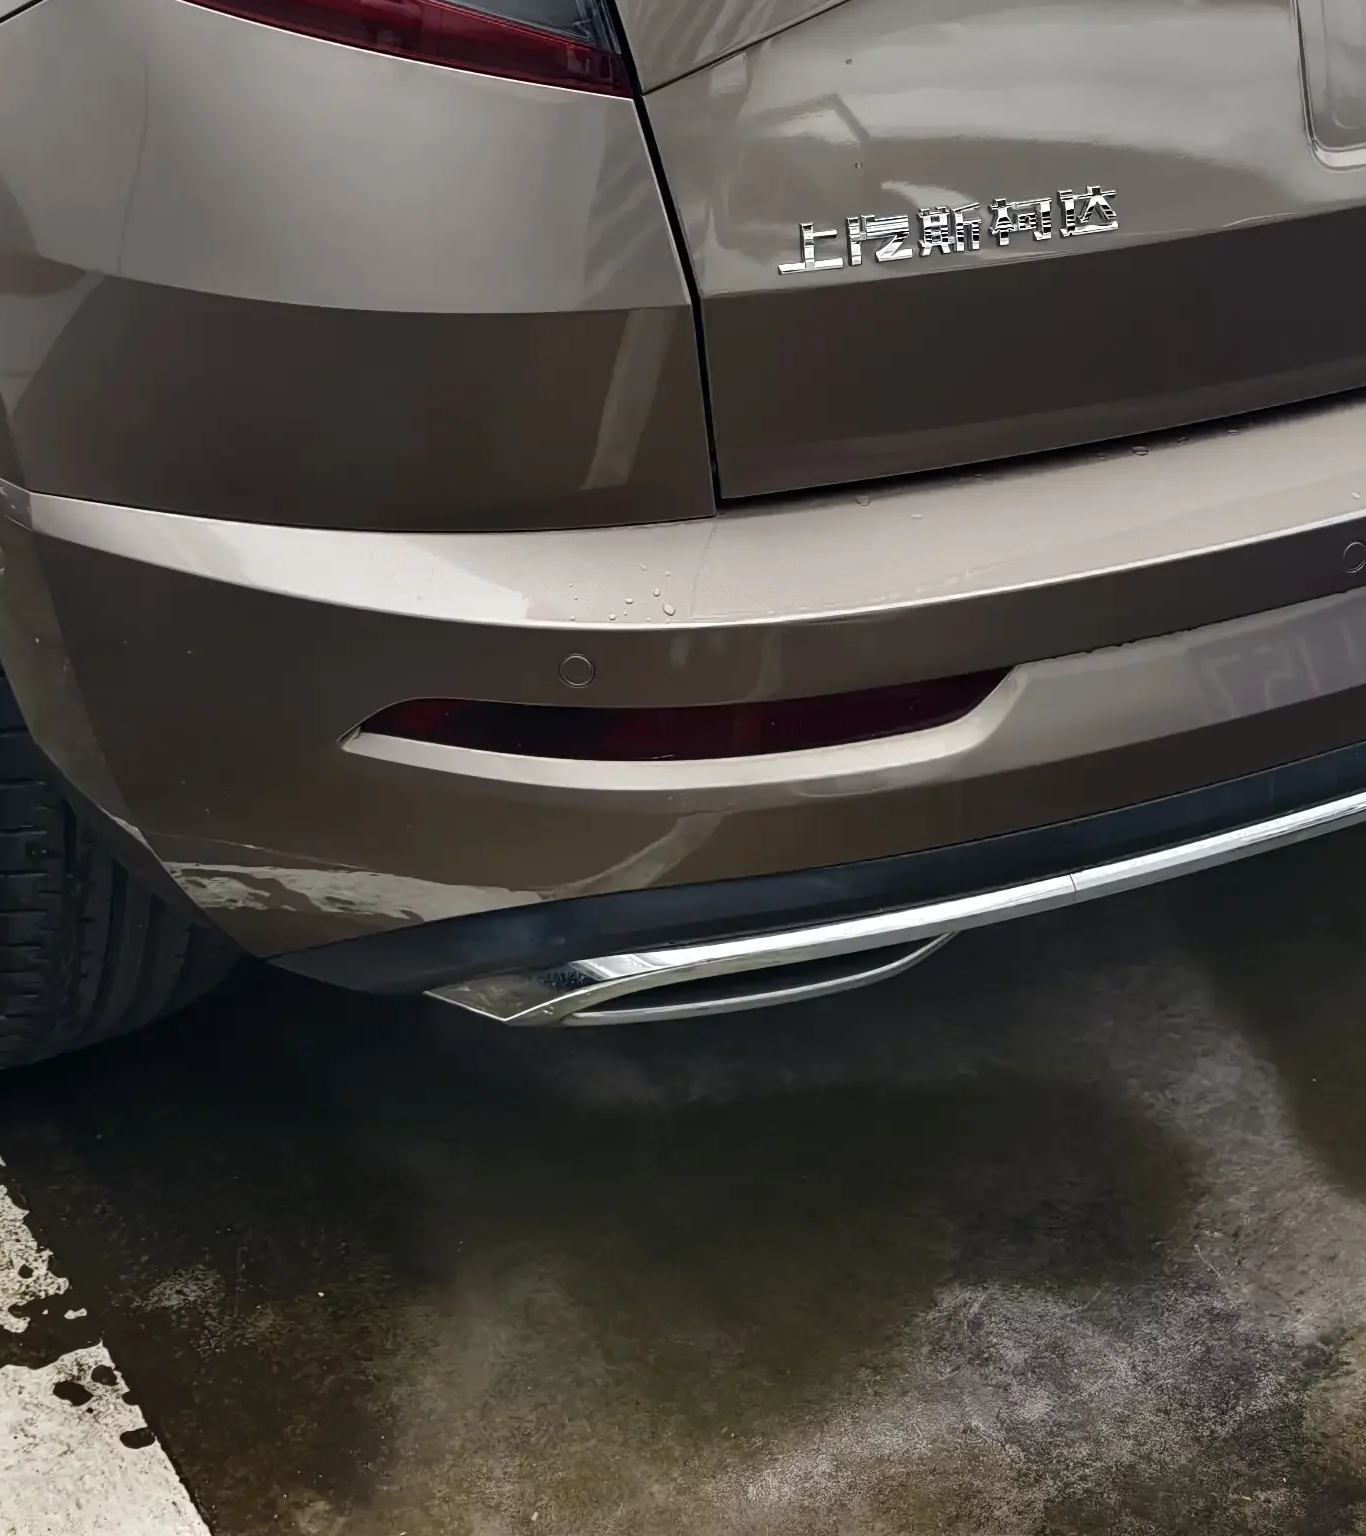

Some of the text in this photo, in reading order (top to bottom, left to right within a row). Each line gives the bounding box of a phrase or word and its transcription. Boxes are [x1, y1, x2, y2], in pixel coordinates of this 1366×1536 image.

[777, 185, 1119, 275] 上汽斯柯达
